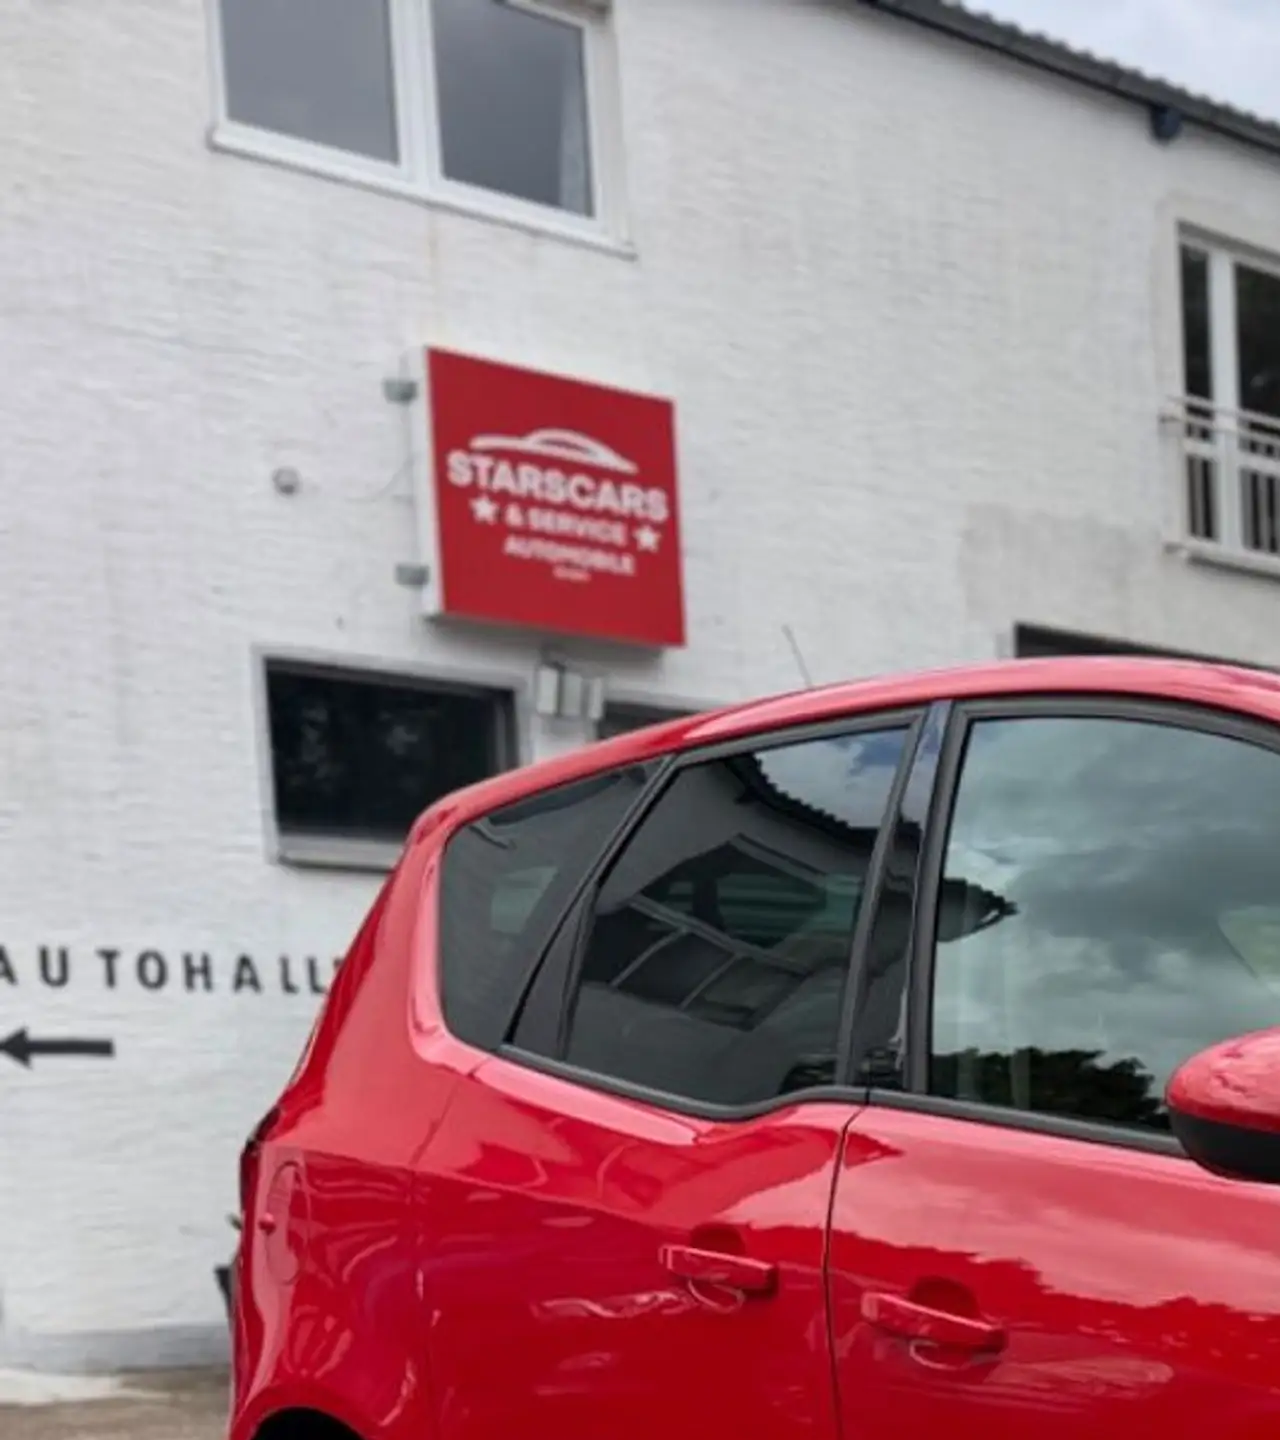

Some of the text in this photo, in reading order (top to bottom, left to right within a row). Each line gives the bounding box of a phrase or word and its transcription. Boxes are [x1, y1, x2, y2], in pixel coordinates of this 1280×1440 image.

[447, 450, 669, 521] STARSCARS
[505, 503, 628, 547] & SERVICE
[504, 535, 636, 576] AUTOMOBILE
